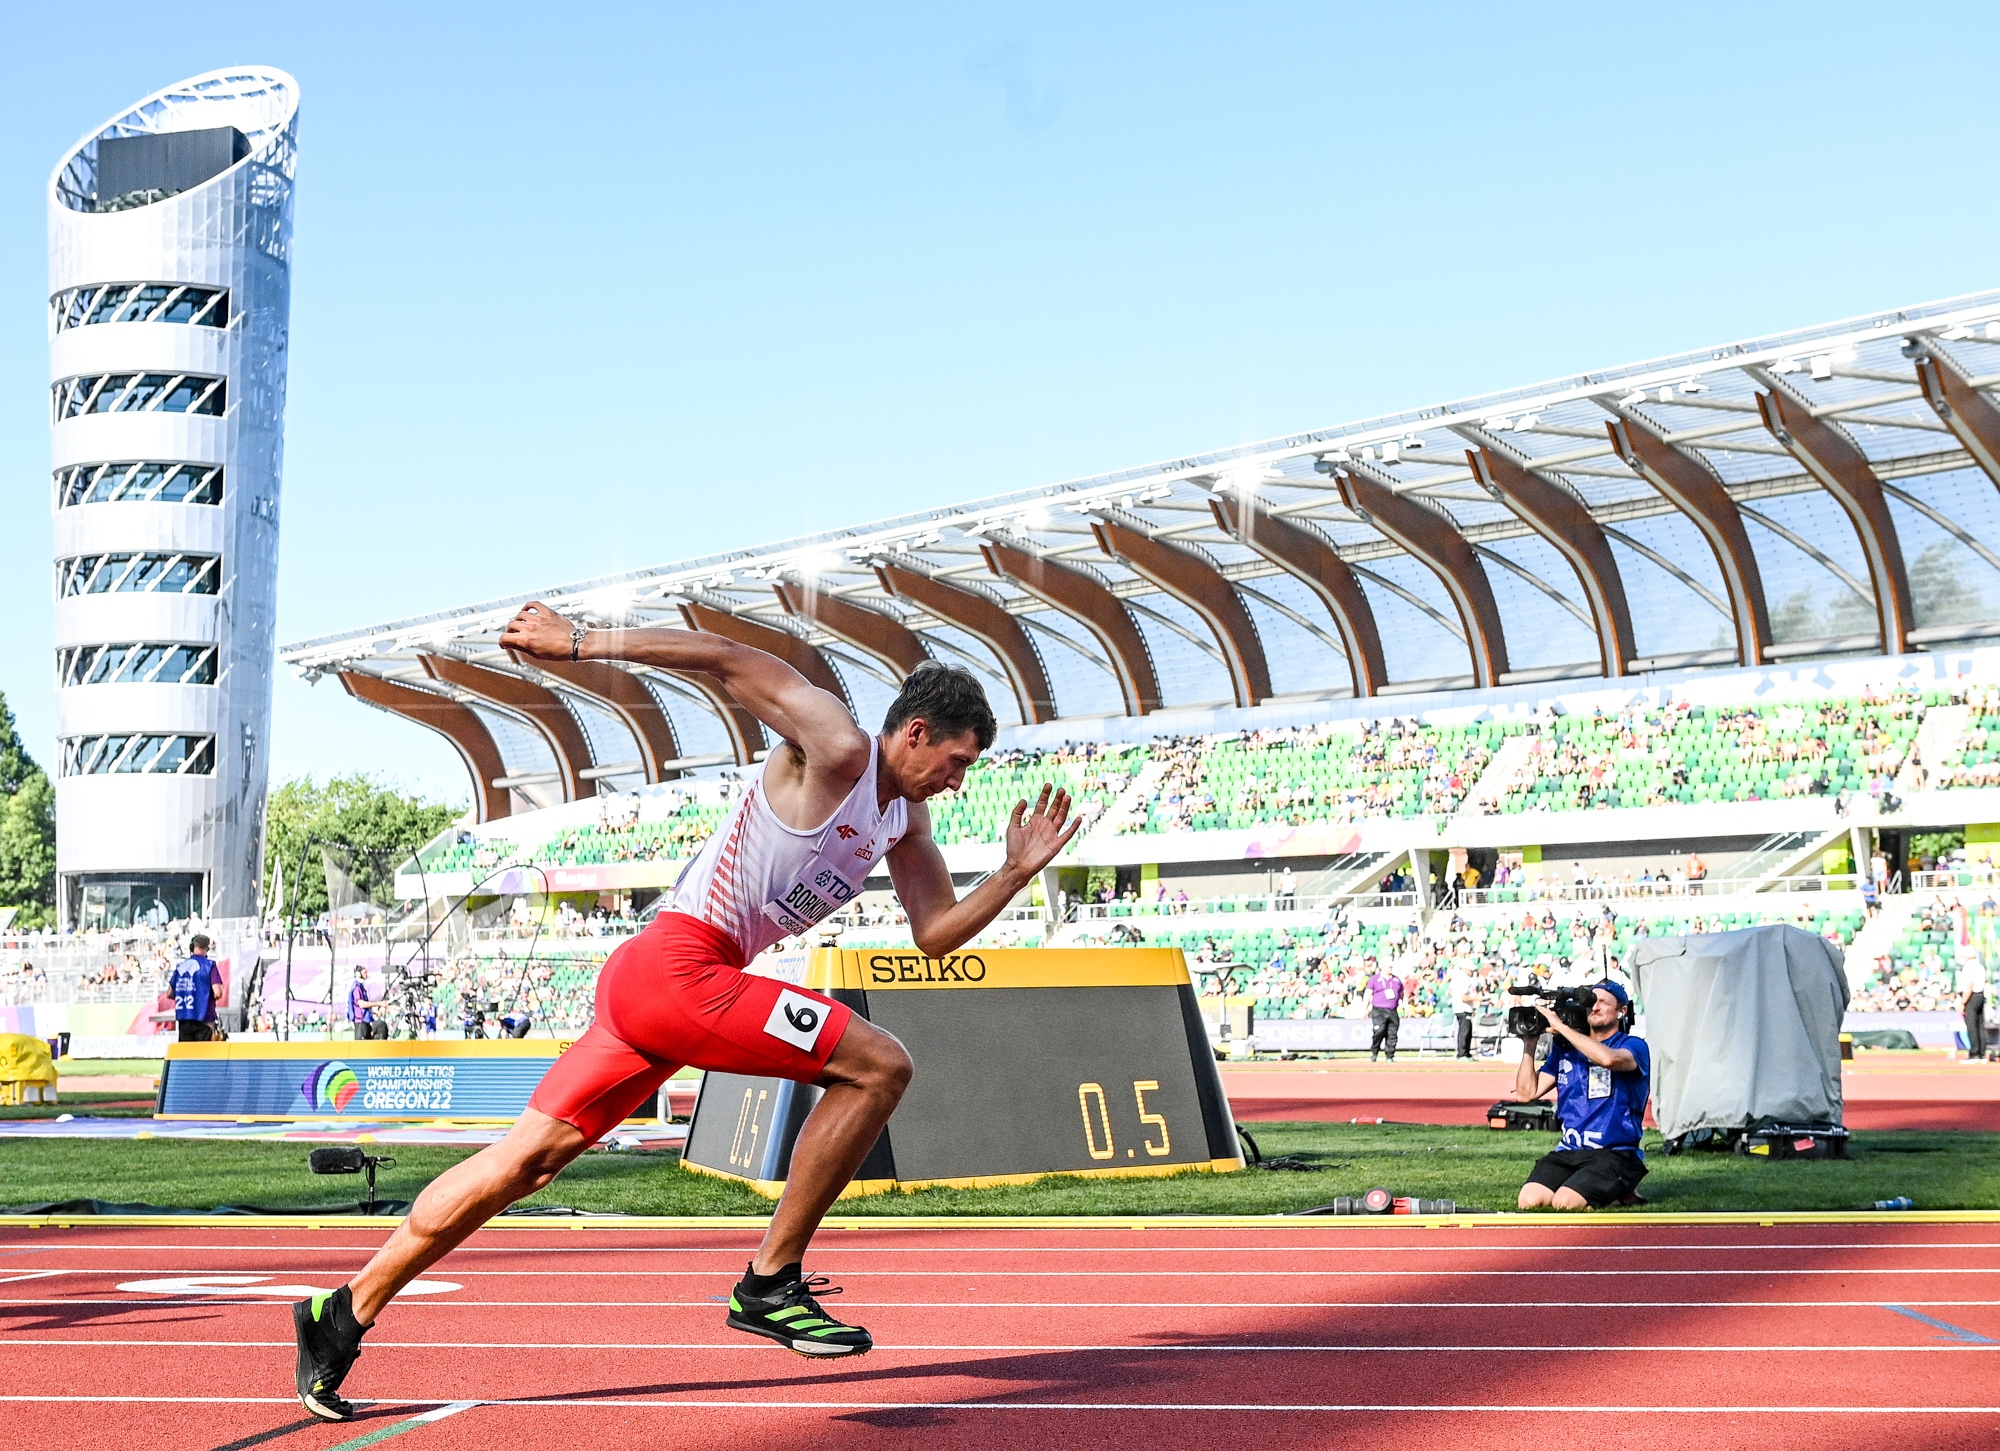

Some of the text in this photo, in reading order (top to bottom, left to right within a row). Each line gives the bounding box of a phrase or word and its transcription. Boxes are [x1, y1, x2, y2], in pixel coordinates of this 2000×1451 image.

[827, 875, 858, 904] TDK
[870, 955, 986, 983] SEIKO
[784, 1002, 818, 1032] 6
[74, 1038, 129, 1054] Nielsen
[366, 1079, 453, 1090] CHAMPIONSHIPS
[367, 1066, 455, 1077] WORLD ATHLETICS
[730, 1088, 768, 1168] 0.5
[1079, 1080, 1170, 1160] 0.5
